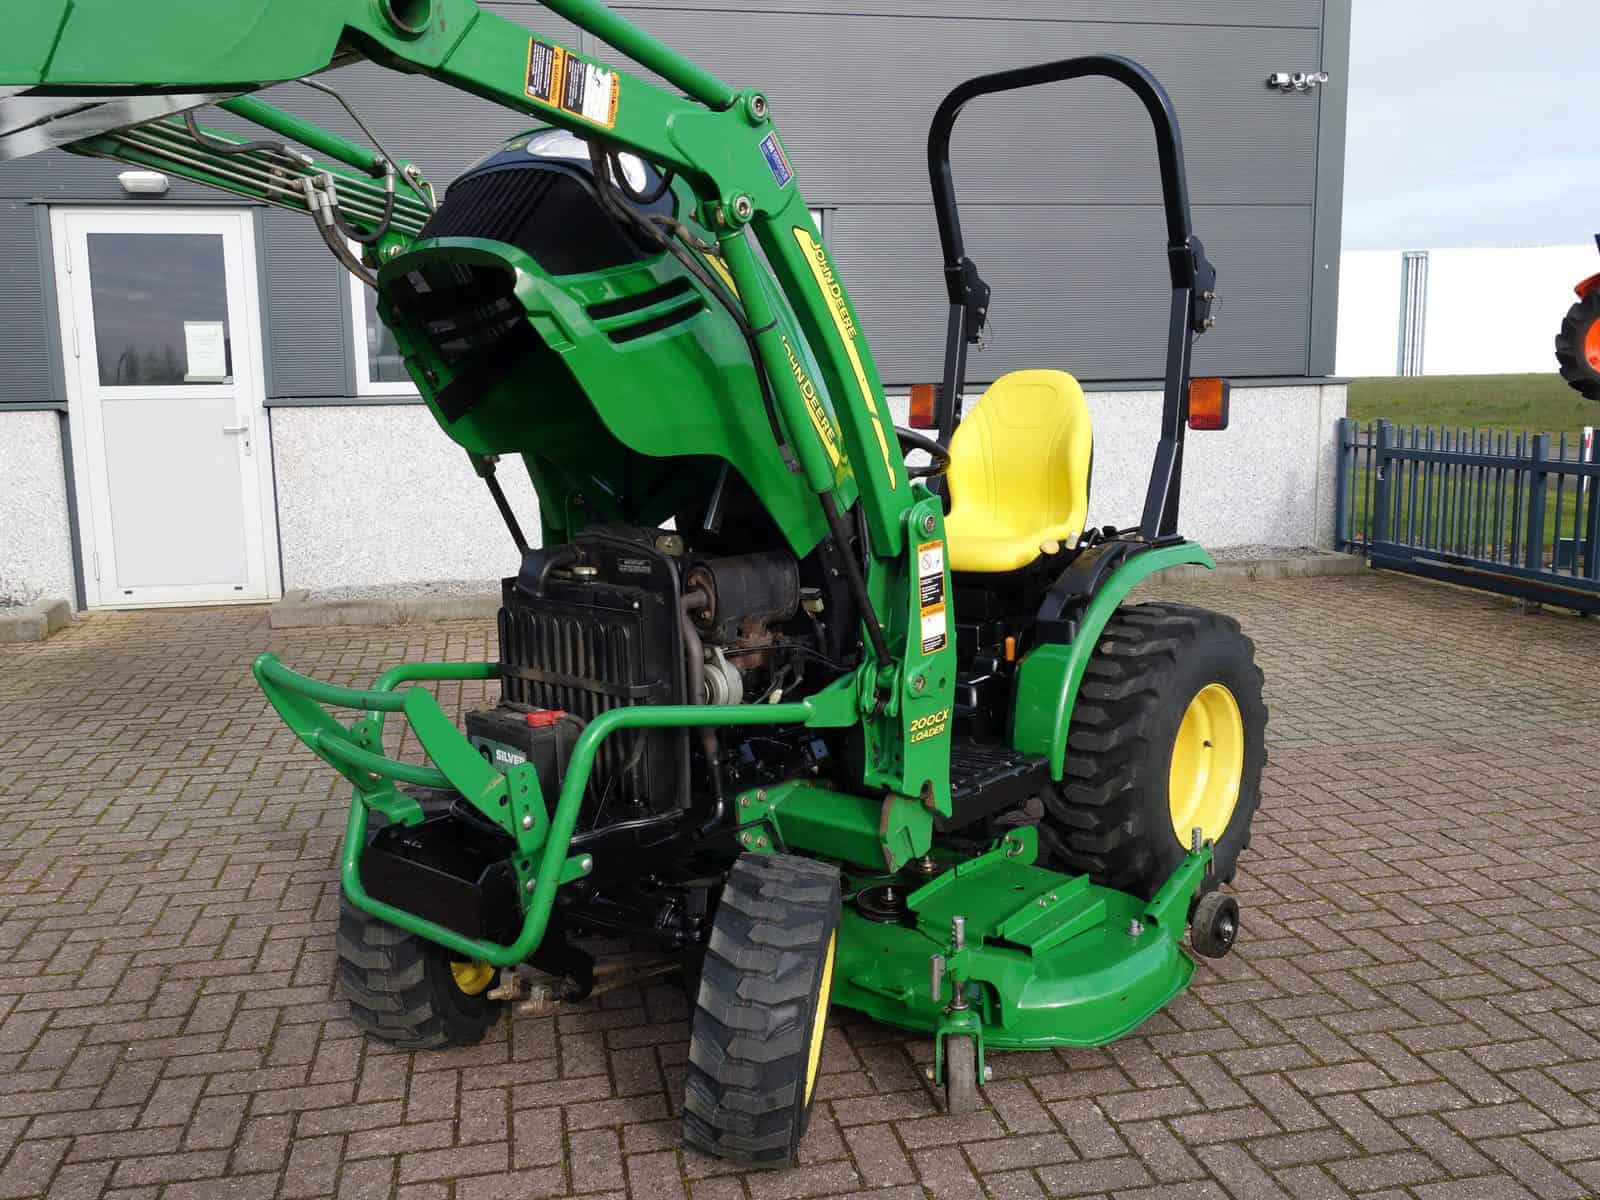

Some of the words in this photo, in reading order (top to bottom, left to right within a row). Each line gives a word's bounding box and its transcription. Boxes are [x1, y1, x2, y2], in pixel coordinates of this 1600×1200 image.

[809, 239, 835, 286] JOHN
[829, 282, 857, 340] DEERE
[801, 379, 835, 441] DEERE
[911, 709, 949, 732] 200CX
[911, 725, 945, 743] LOADER
